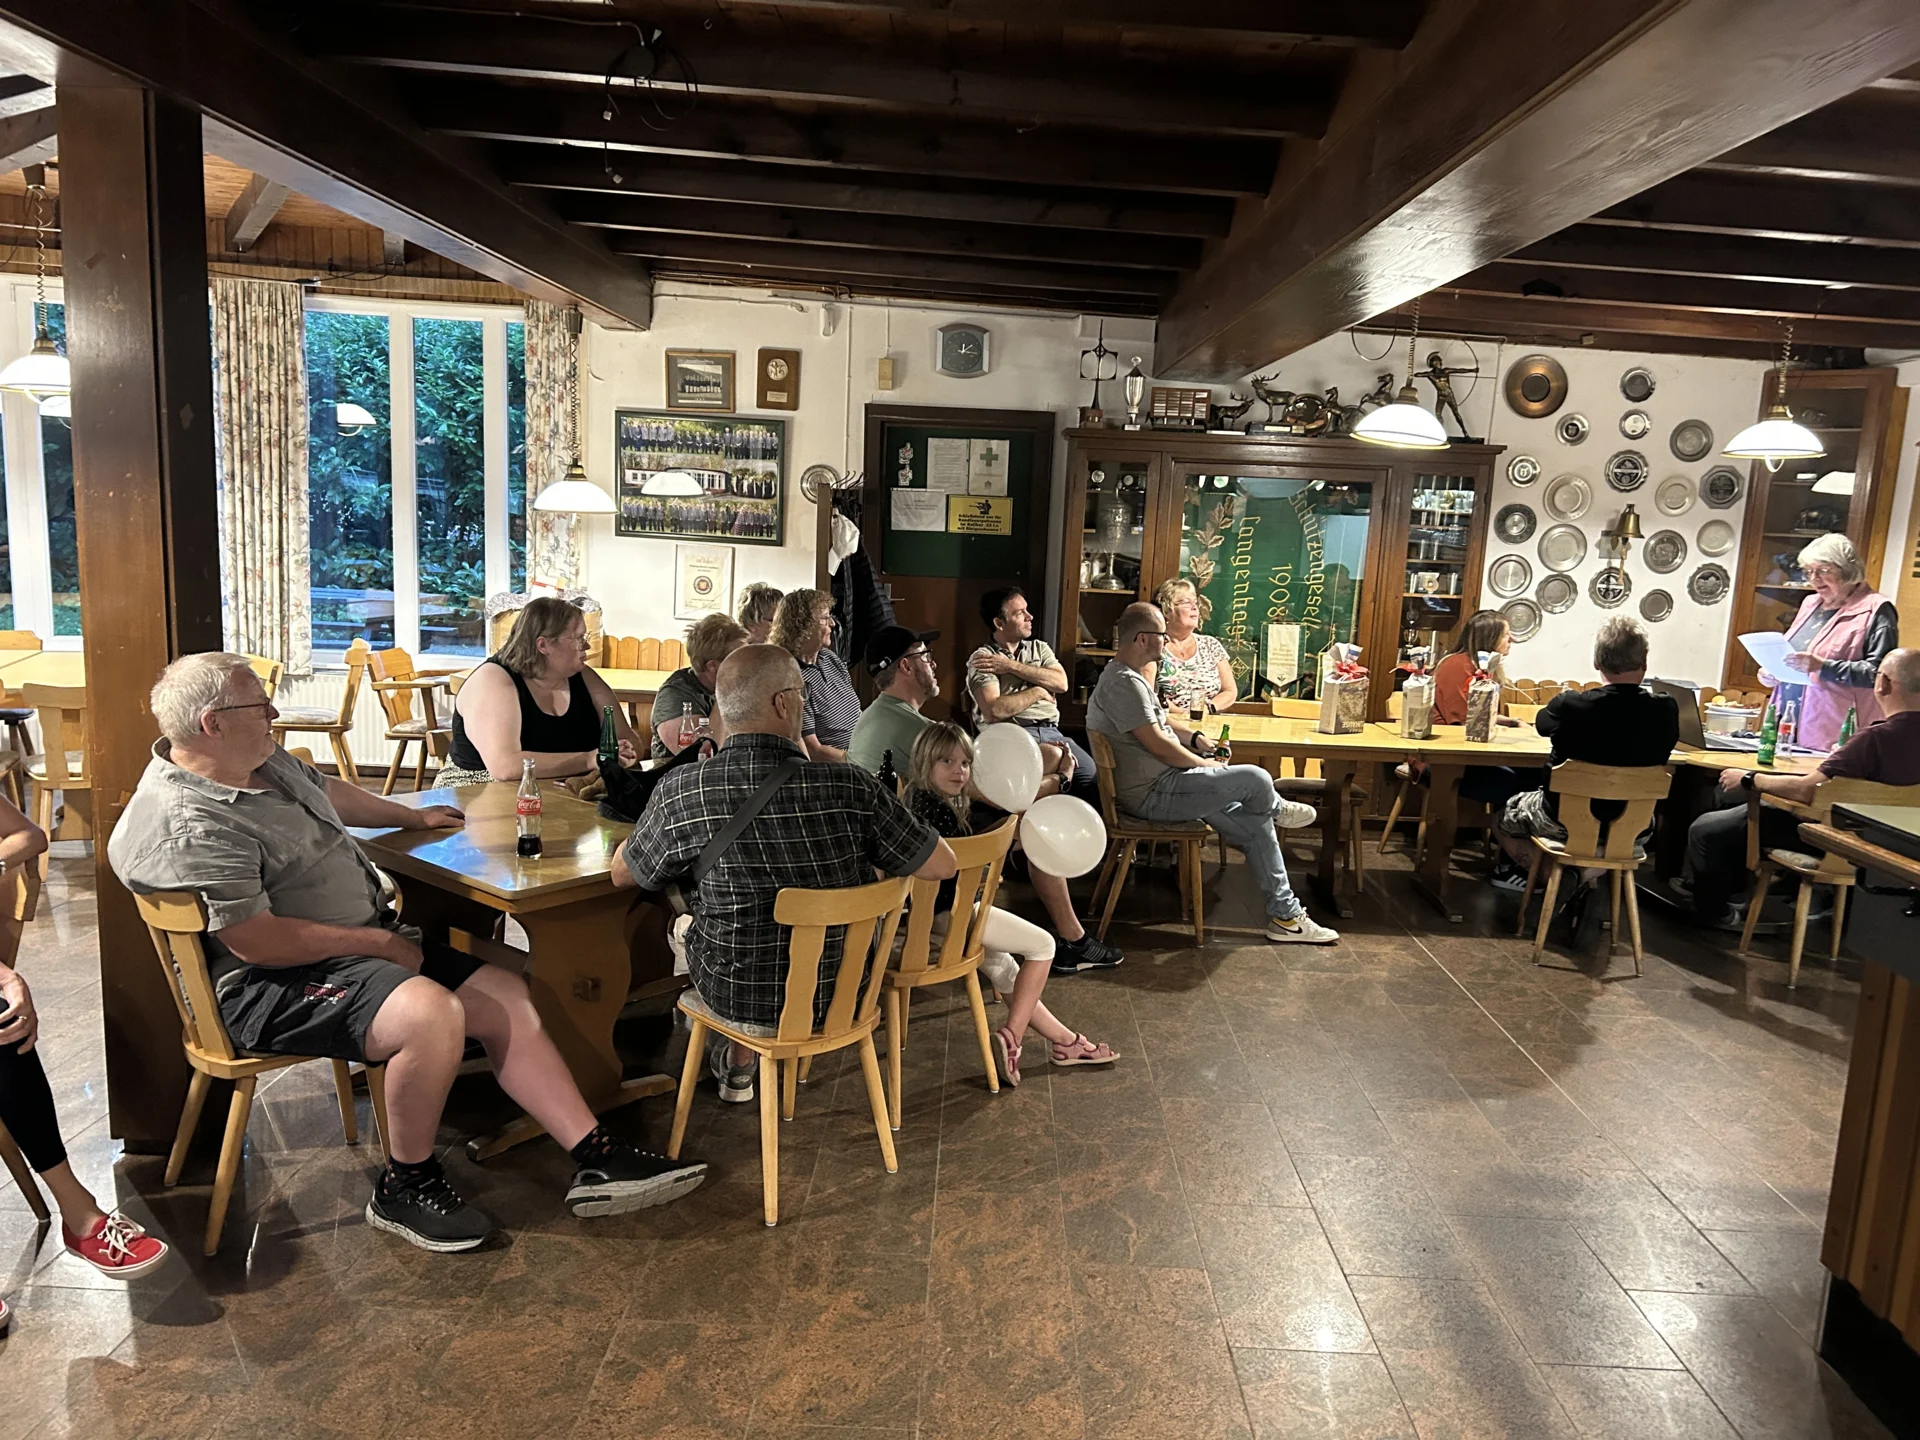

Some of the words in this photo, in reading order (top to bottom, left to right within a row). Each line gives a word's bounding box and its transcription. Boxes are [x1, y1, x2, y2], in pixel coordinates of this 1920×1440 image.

[1225, 515, 1261, 636] Langenhag
[1267, 564, 1292, 618] 1908
[1288, 489, 1327, 638] Schützengesell
